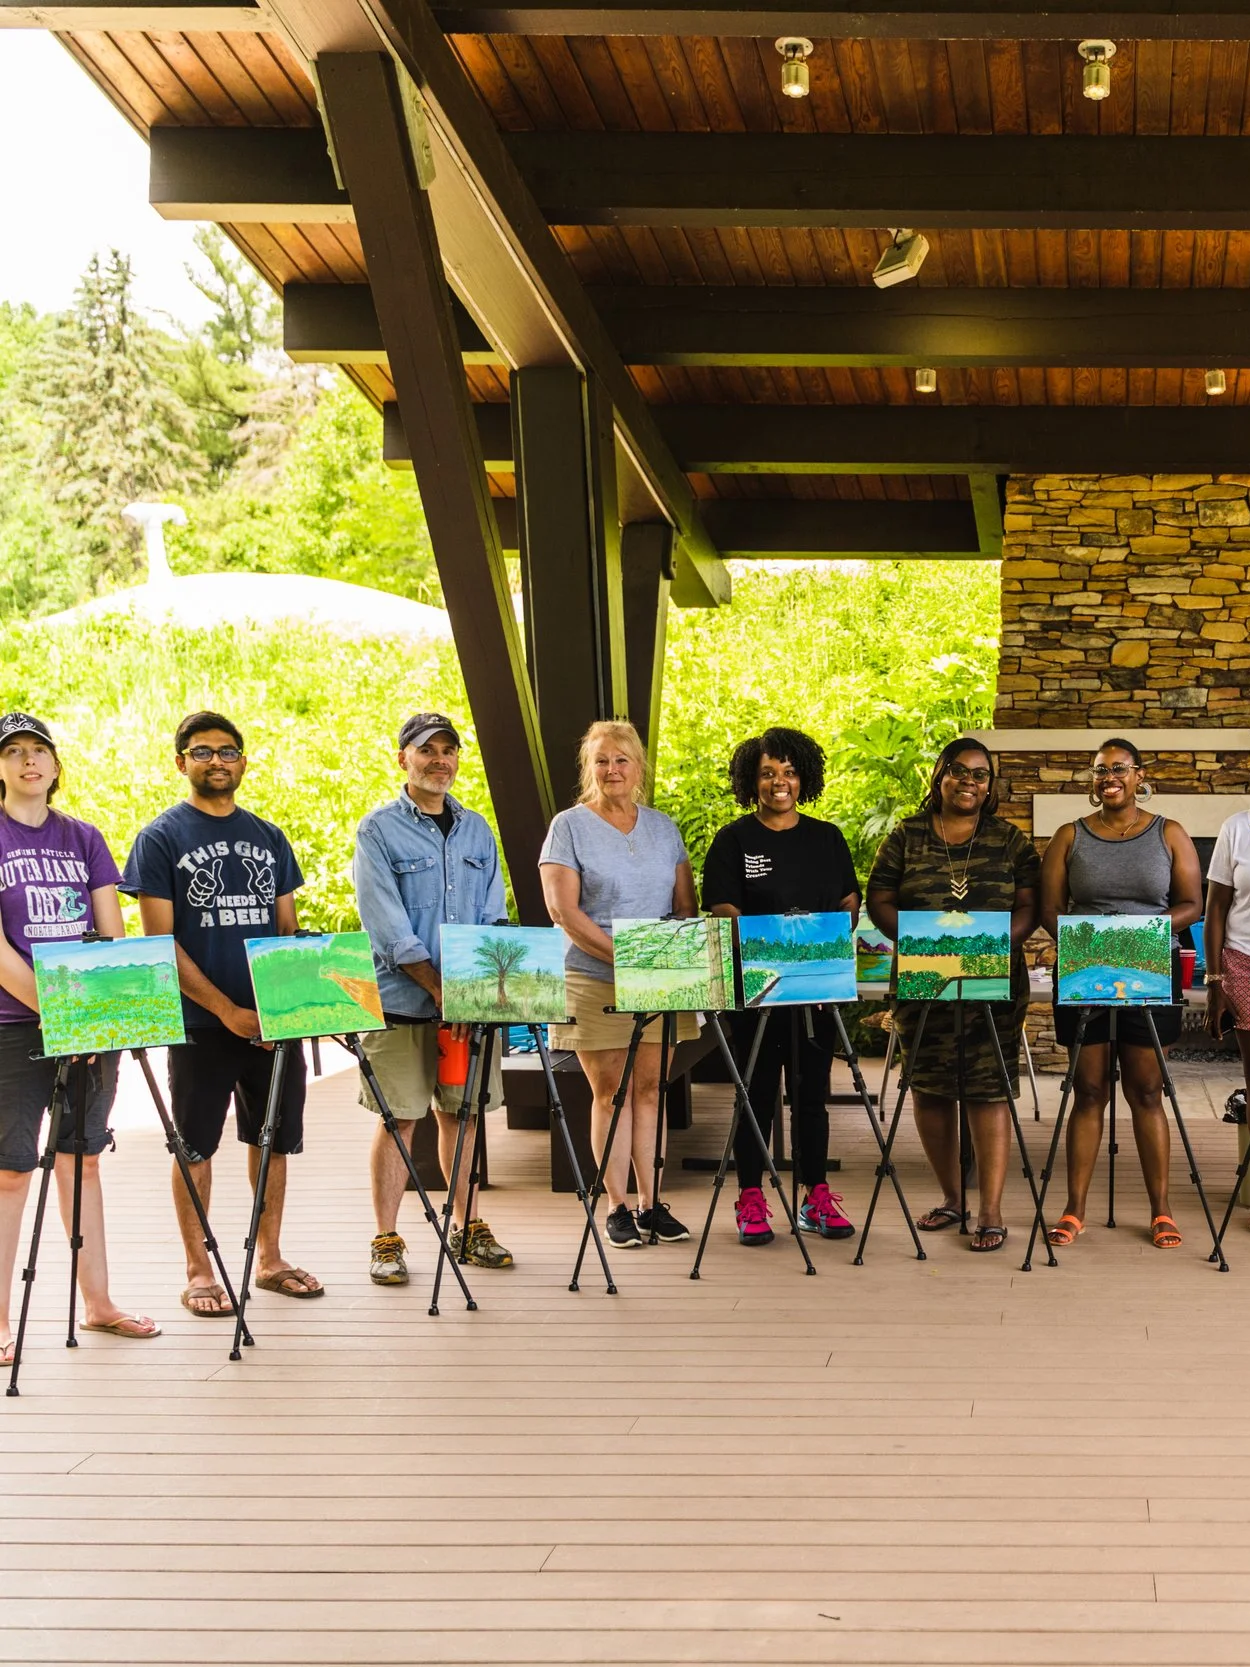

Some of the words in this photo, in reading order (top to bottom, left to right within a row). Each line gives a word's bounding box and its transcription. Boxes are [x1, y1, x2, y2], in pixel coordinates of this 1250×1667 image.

[176, 841, 230, 874] THIS
[234, 840, 276, 867] GUY
[216, 894, 257, 908] NEEDS
[200, 911, 215, 928] A
[27, 925, 53, 937] NORTH
